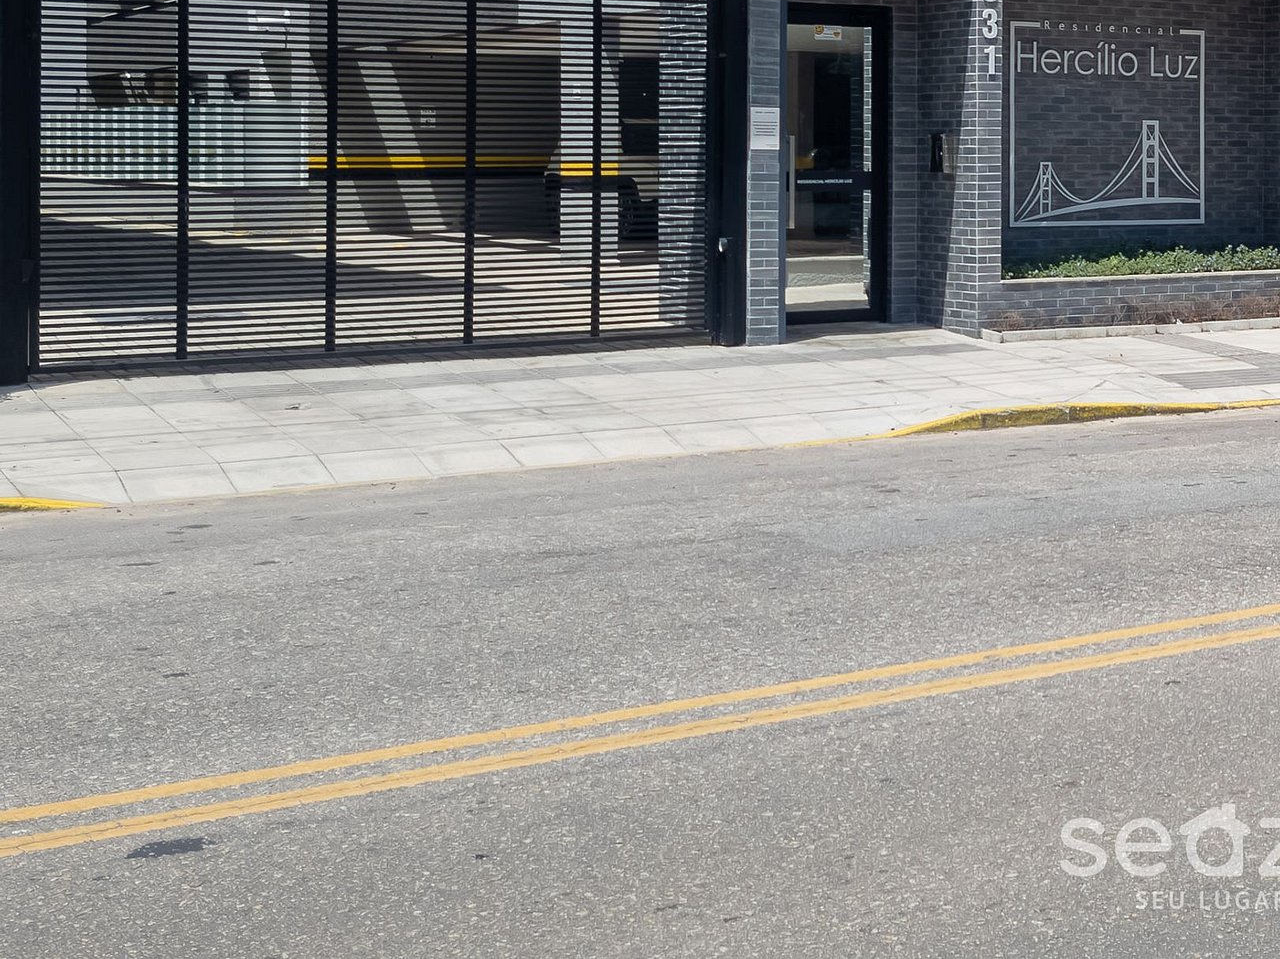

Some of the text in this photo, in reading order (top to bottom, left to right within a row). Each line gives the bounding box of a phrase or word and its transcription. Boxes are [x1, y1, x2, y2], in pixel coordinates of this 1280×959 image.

[1044, 20, 1174, 36] Residencial
[1017, 41, 1198, 78] Hercílio Luz
